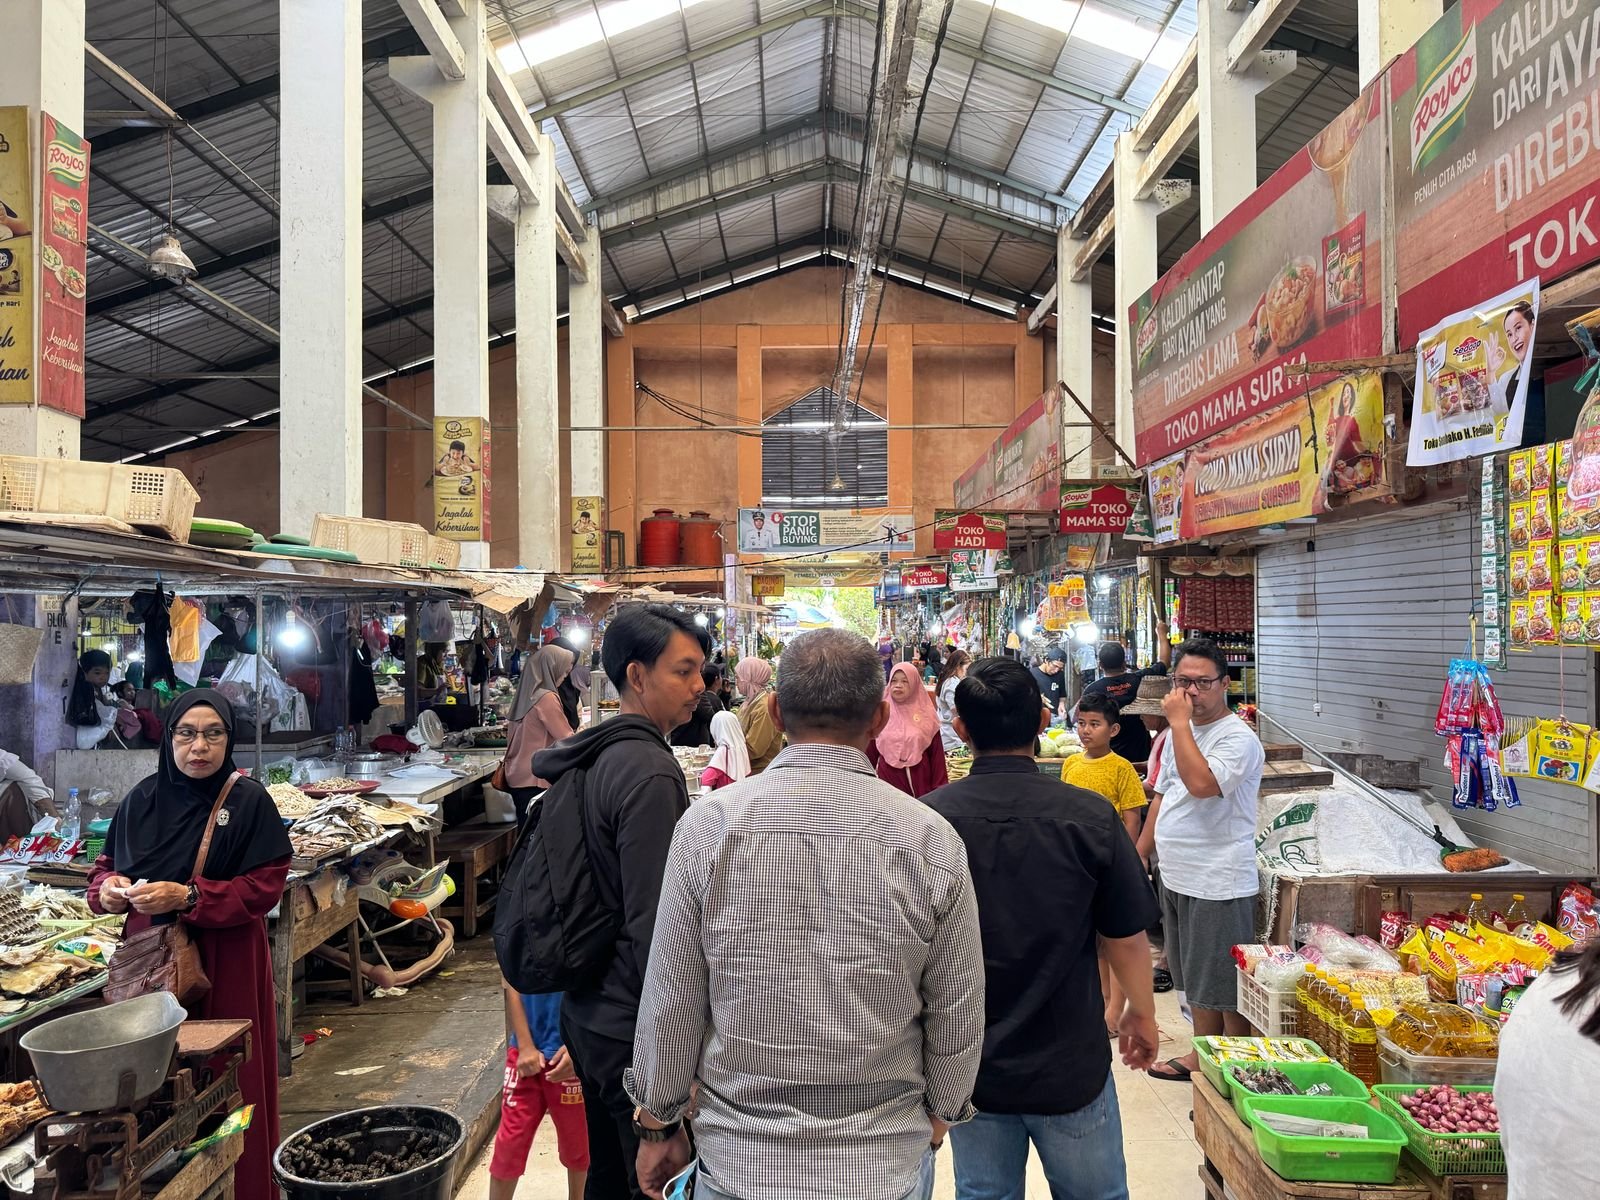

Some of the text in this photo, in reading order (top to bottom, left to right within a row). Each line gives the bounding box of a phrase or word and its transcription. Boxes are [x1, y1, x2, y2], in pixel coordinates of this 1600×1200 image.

[1414, 54, 1475, 148] Royco
[1492, 58, 1541, 130] DARI
[49, 147, 85, 172] Royco
[1414, 148, 1477, 207] PENUH CITA RASA
[1161, 261, 1225, 336] KALDU MANTAP
[1162, 296, 1227, 363] DARI AYAM YANG
[47, 328, 80, 353] Jagalah
[43, 346, 83, 375] Kebersihan
[1164, 332, 1240, 408] DIREBUS LAMA
[1165, 411, 1200, 447] TOKO
[1202, 386, 1247, 431] MAMA
[1424, 439, 1438, 450] Toko
[1463, 428, 1473, 440] H.
[1261, 429, 1301, 479] SURYA
[1102, 468, 1119, 476] Kios
[1063, 493, 1089, 503] Royco
[438, 506, 474, 520] Jagalah
[1090, 503, 1127, 514] TOKO
[435, 521, 480, 532] Kebersihan
[782, 515, 817, 527] STOP
[1066, 516, 1106, 527] MAMA
[783, 526, 817, 536] PANIC
[957, 526, 984, 535] TOKO
[782, 535, 818, 545] BUYING
[954, 536, 986, 547] HADI
[47, 612, 68, 628] BLOK
[54, 631, 62, 645] E
